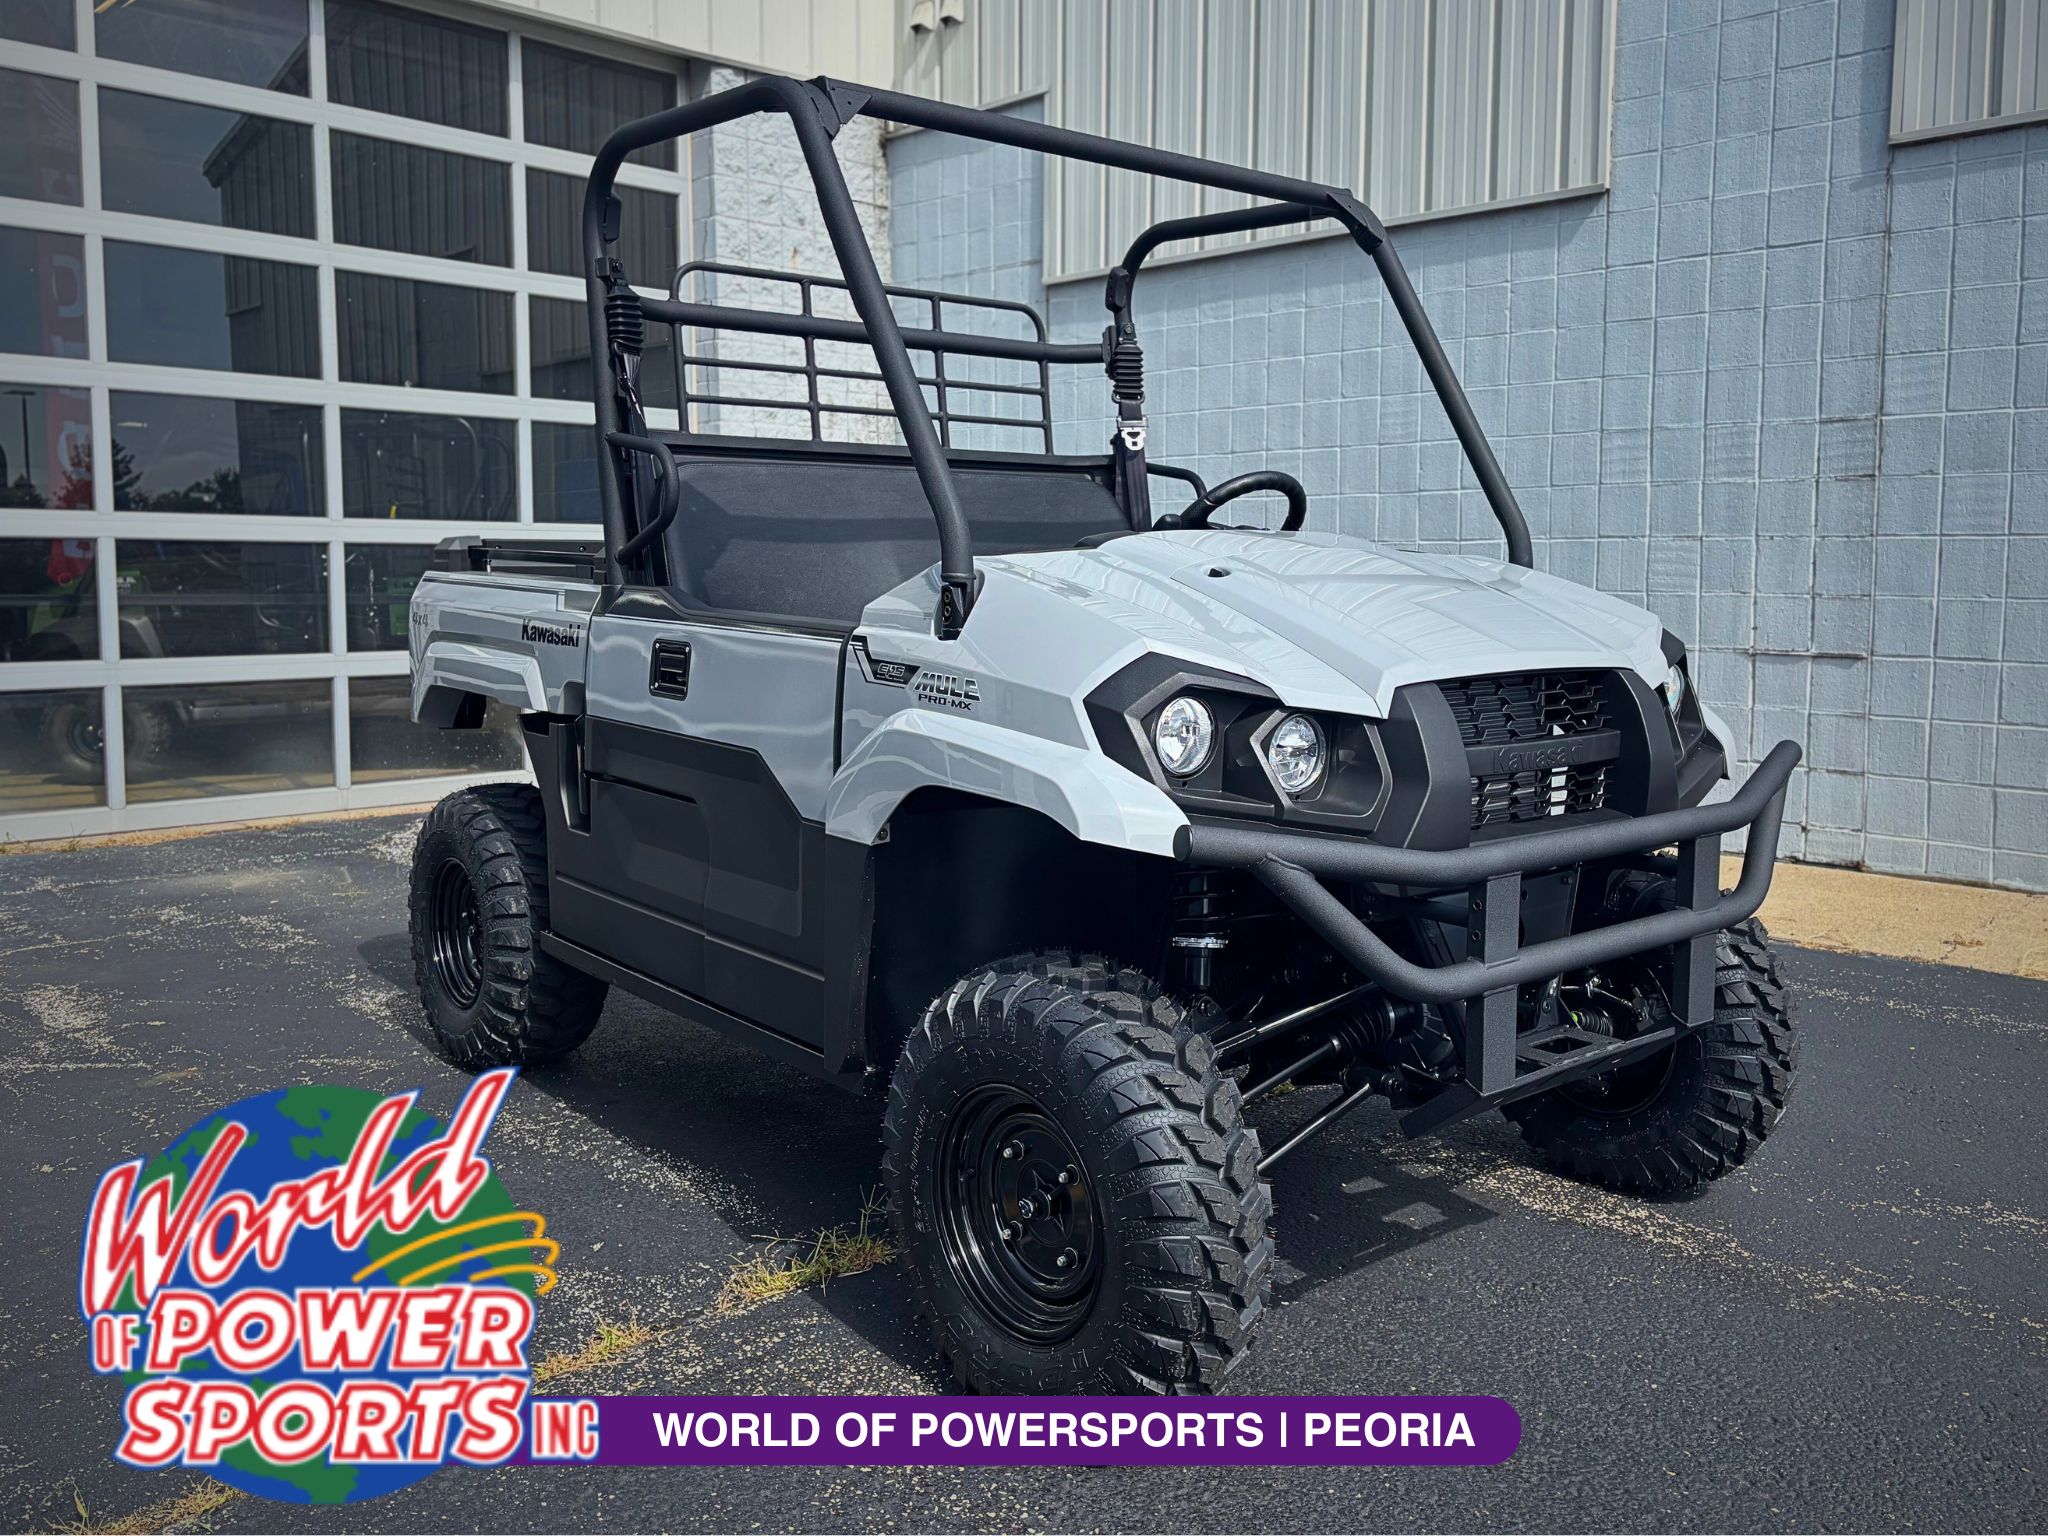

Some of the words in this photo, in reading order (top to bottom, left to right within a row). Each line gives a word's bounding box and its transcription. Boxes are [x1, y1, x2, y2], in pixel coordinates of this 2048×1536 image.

[521, 618, 581, 648] Kawasaki
[878, 662, 906, 677] EPS
[913, 670, 982, 702] MULE
[1494, 742, 1584, 773] Kawasaki
